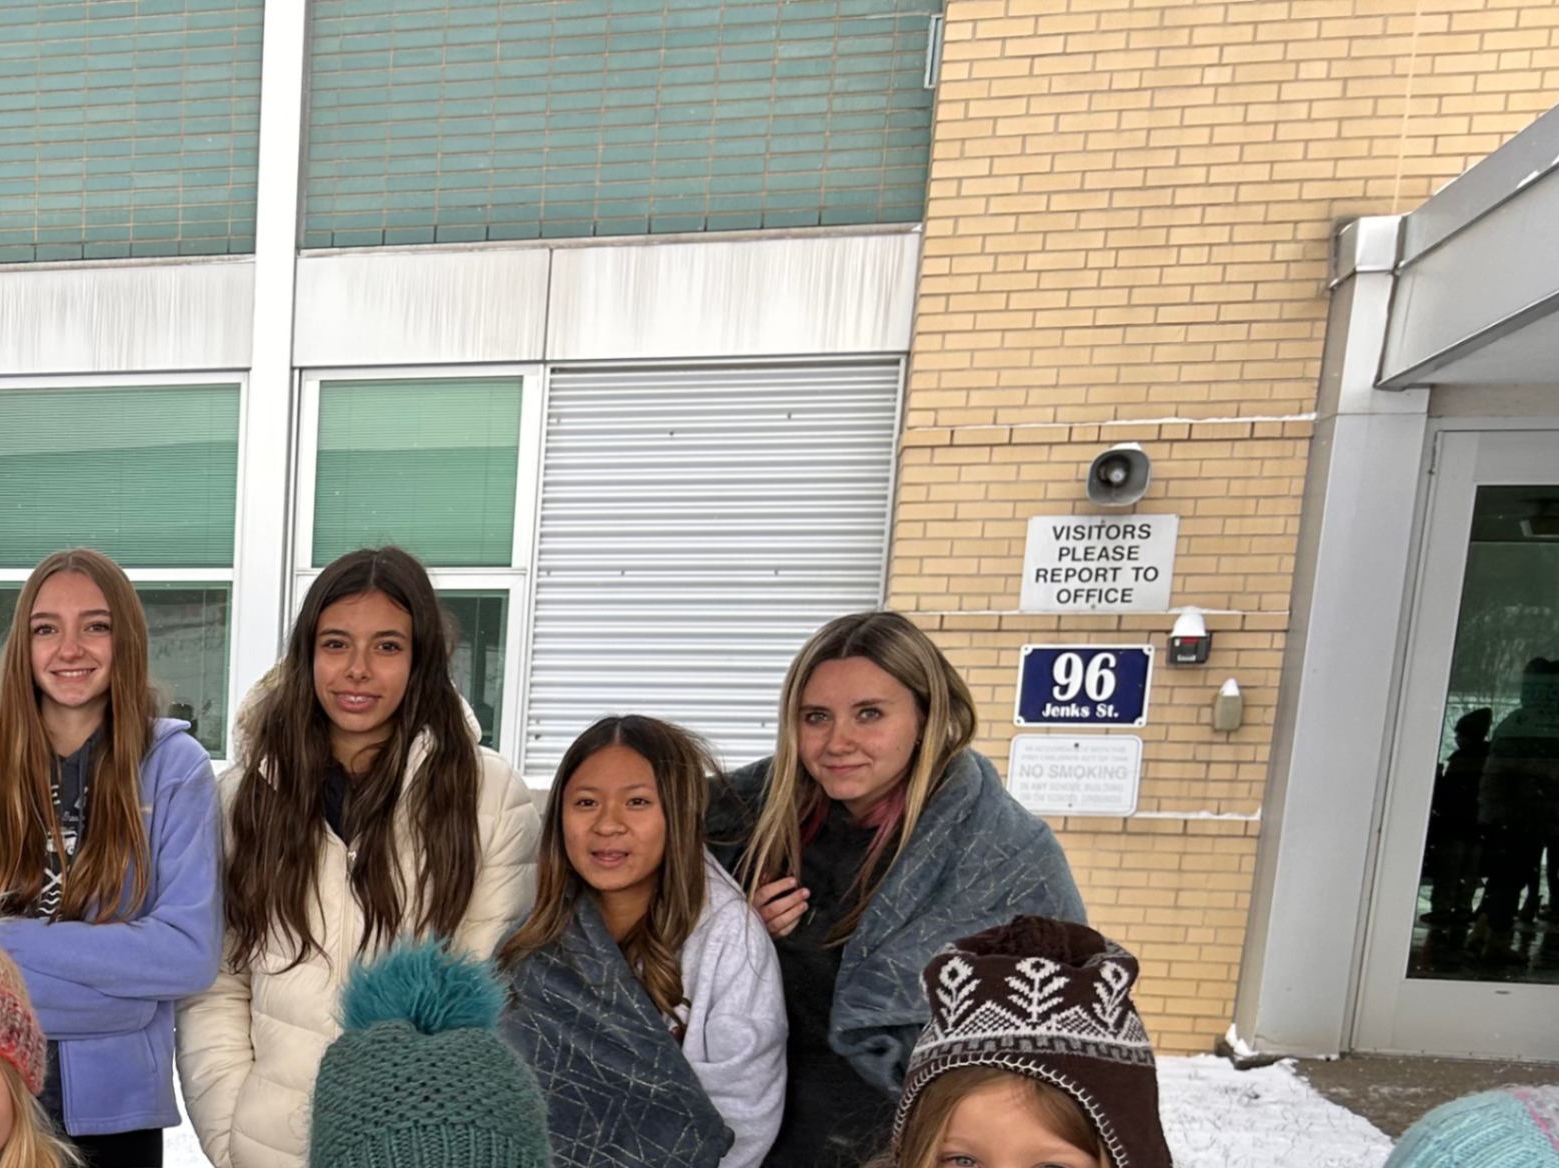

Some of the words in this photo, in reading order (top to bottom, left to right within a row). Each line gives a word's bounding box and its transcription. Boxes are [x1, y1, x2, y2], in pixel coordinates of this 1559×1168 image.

[1052, 524, 1151, 541] VISITORS
[1058, 545, 1140, 562] PLEASE
[1035, 567, 1122, 583] REPORT
[1131, 566, 1159, 582] TO
[1056, 588, 1134, 604] OFFICE
[1052, 652, 1117, 701] 96
[1042, 703, 1090, 718] Jenks
[1096, 703, 1119, 718] St.
[1019, 764, 1043, 778] NO
[1048, 764, 1128, 780] SMOKING
